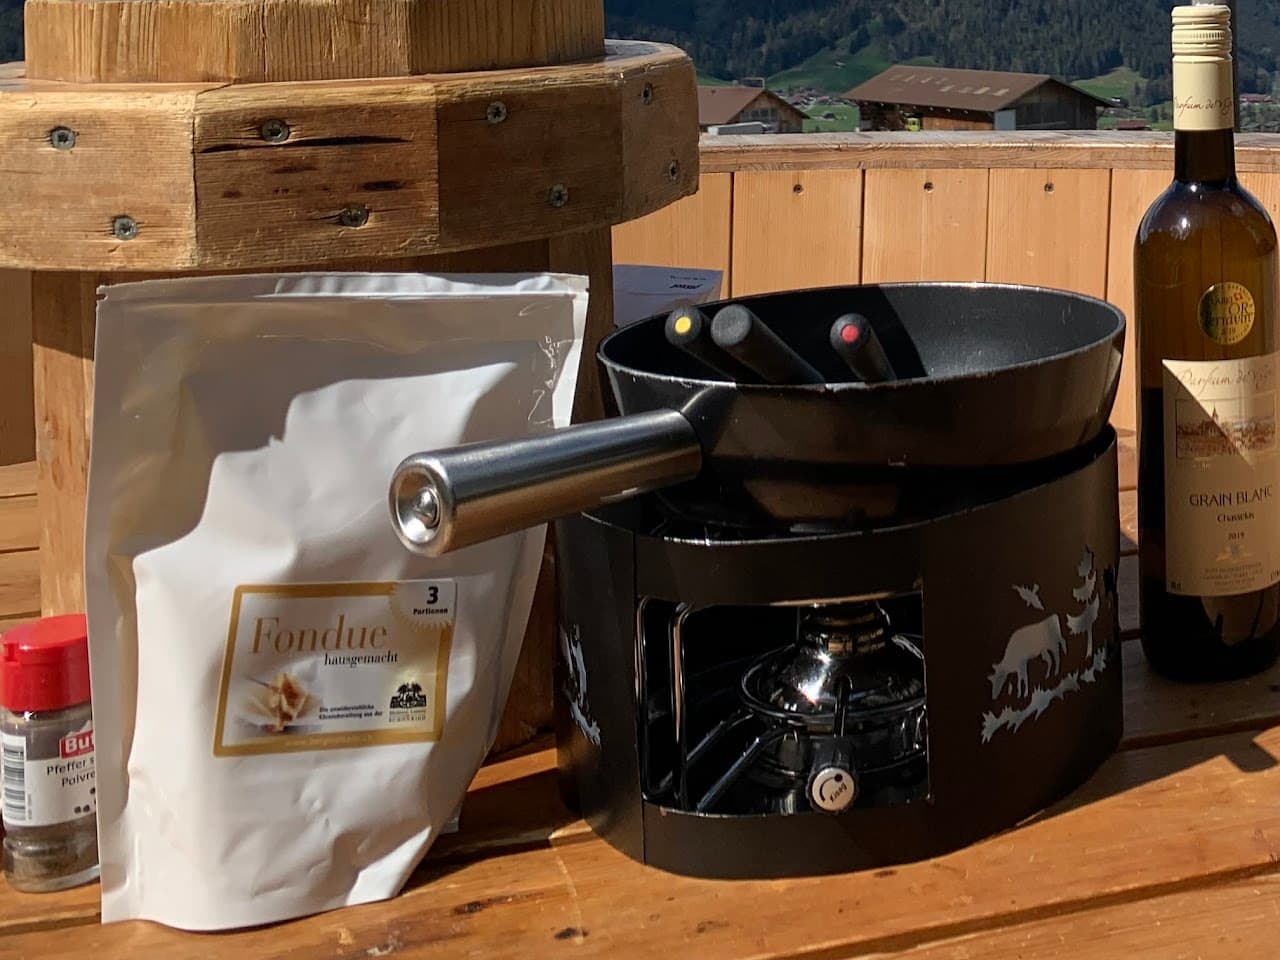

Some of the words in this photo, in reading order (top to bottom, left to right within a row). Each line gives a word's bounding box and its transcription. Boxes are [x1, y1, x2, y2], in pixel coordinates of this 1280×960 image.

[1189, 493, 1232, 507] GRAIN
[1236, 485, 1273, 504] BLANC
[426, 586, 439, 605] 3
[251, 614, 388, 655] Fondue
[323, 650, 398, 669] hausgemacht
[46, 759, 87, 776] Pfeffer
